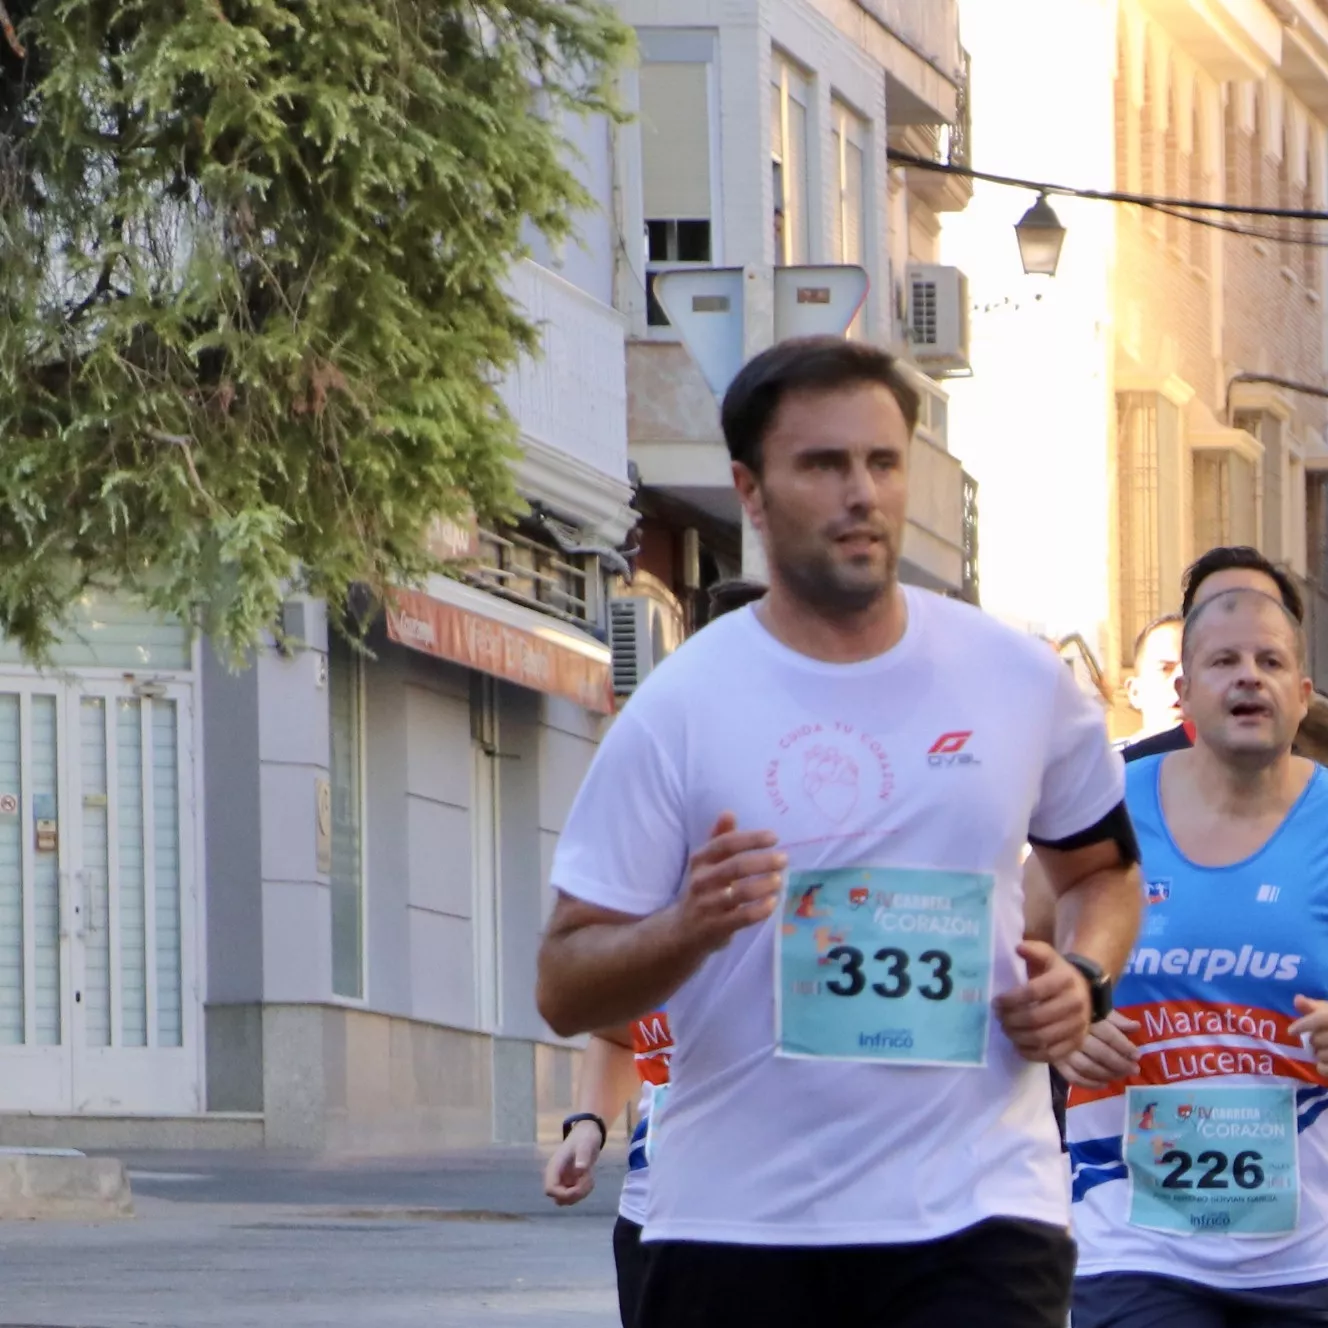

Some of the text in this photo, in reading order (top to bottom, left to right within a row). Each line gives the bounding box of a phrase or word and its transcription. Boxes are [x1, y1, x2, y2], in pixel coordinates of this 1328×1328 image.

[779, 723, 822, 749] CUIDA
[826, 945, 953, 1001] 333
[1143, 1007, 1276, 1042] Maratón
[1160, 1051, 1274, 1079] Lucena
[1162, 1150, 1265, 1190] 226
